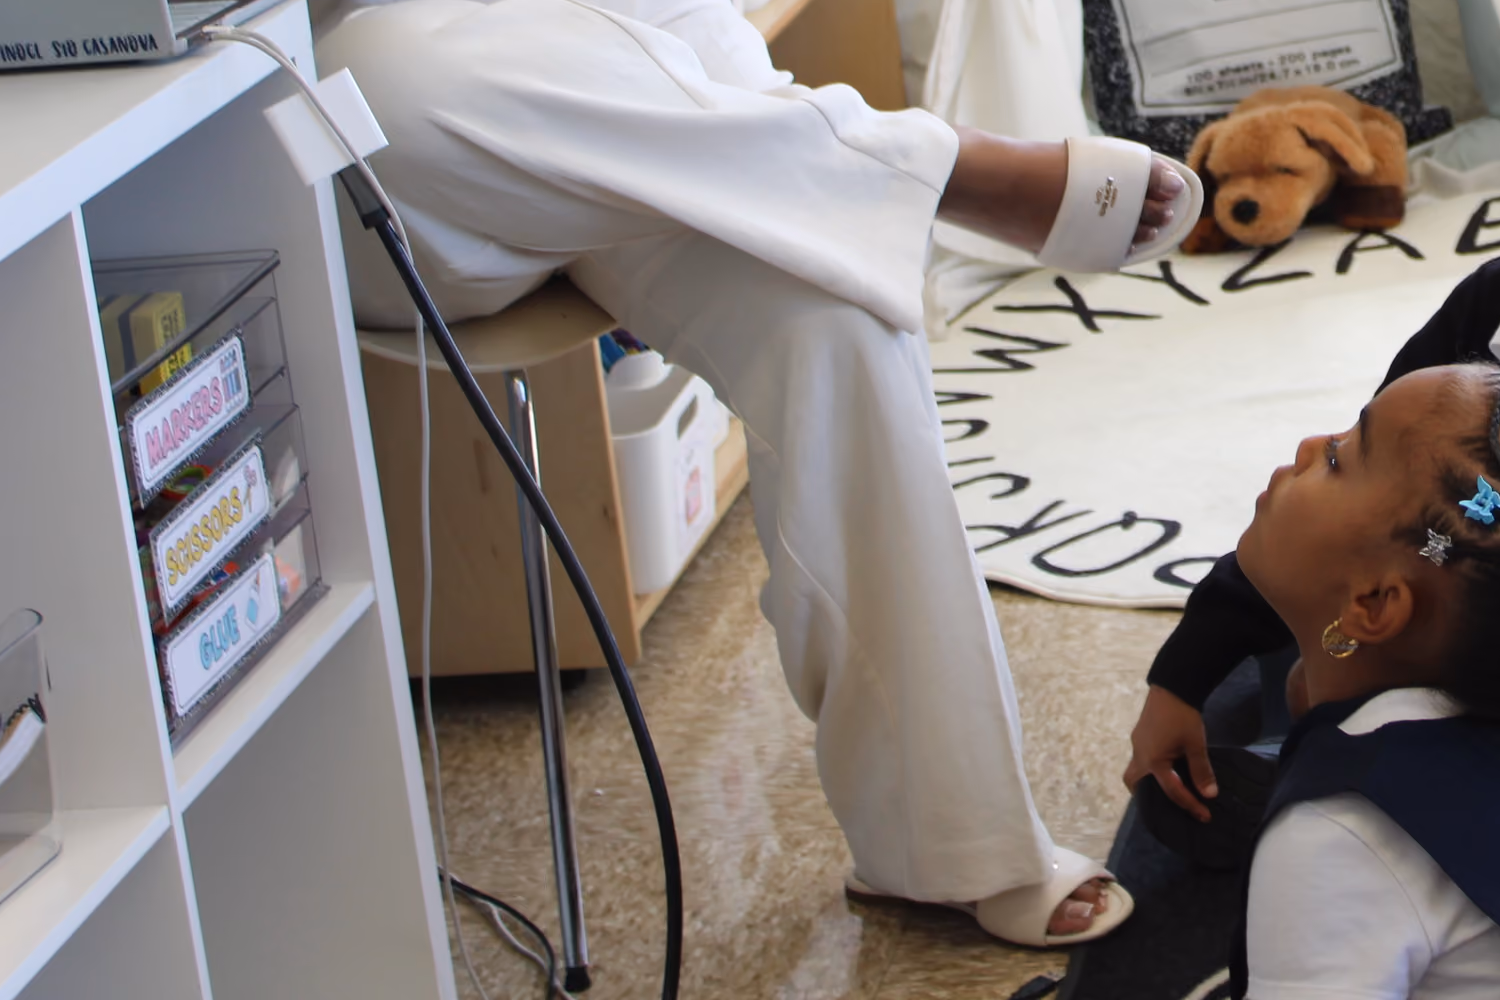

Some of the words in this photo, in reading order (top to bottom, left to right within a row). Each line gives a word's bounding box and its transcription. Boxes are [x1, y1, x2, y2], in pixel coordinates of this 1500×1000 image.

[82, 33, 159, 57] CASANOVA
[1187, 68, 1214, 84] 100
[1219, 59, 1264, 77] sheets
[1279, 52, 1307, 67] 200
[1312, 45, 1353, 62] pages
[994, 275, 1163, 334] X
[1335, 229, 1425, 275] A
[145, 376, 224, 469] MARKERS
[165, 486, 244, 586] SCISSORS
[199, 603, 241, 671] GLUE
